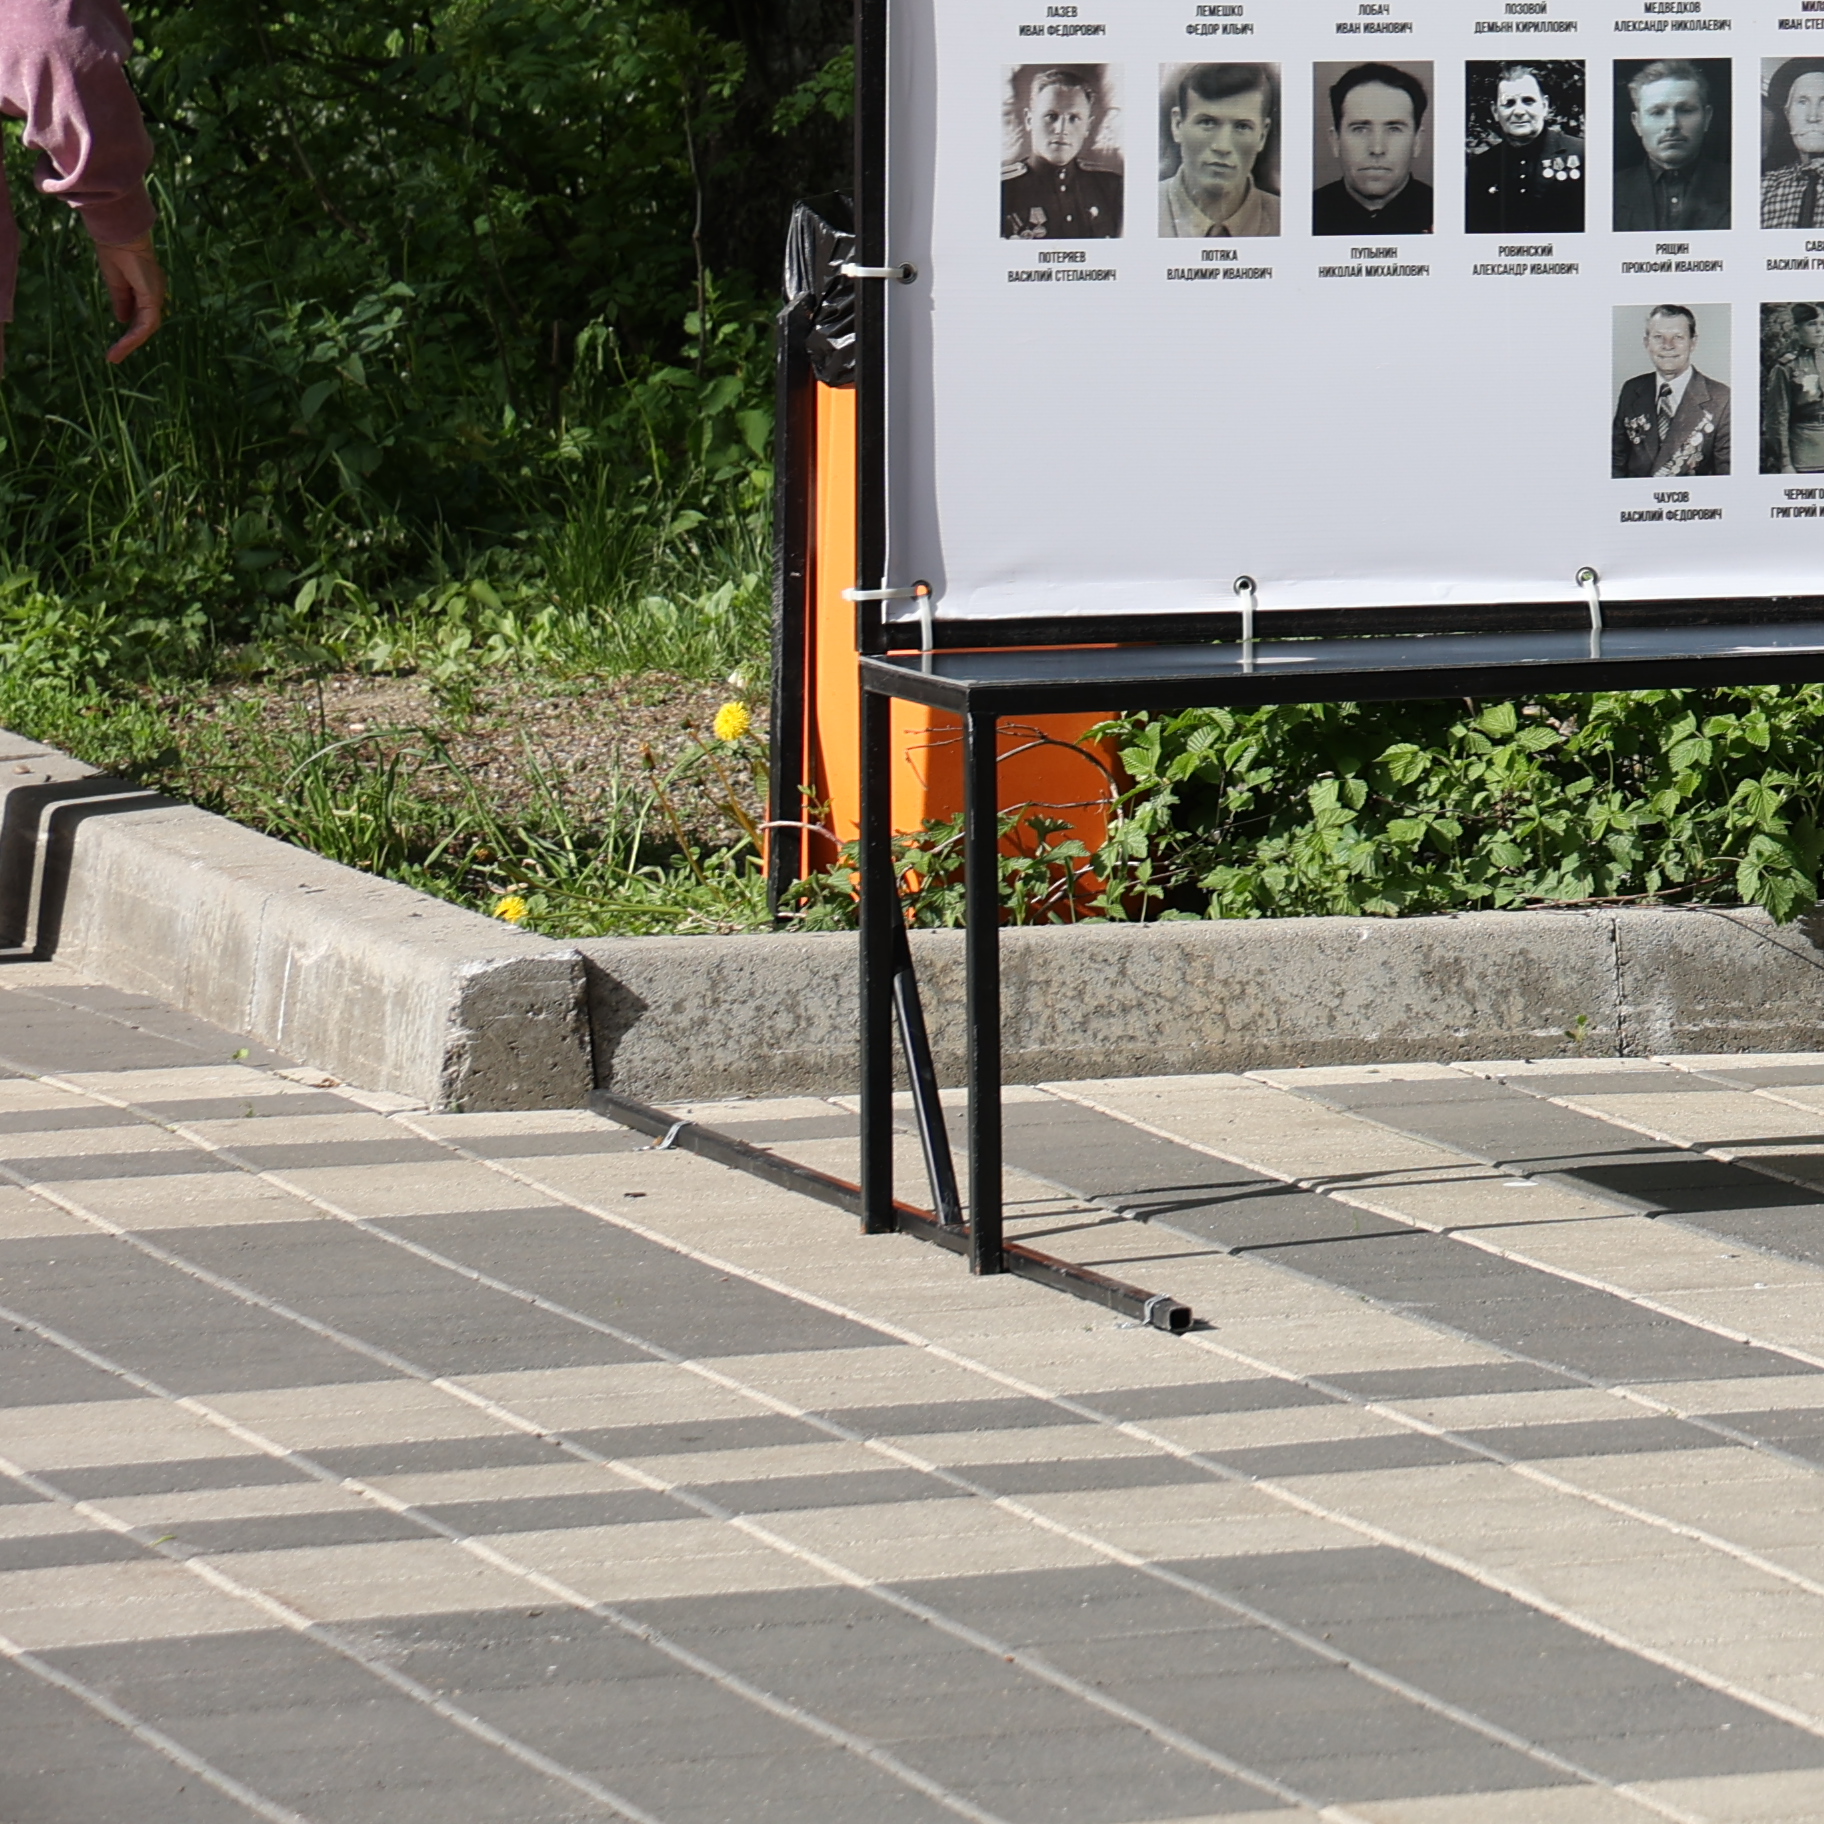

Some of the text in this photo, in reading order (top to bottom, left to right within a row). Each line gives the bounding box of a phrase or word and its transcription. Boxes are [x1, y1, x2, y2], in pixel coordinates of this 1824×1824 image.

[1046, 5, 1078, 18] ЛАЗЕВ
[1195, 4, 1244, 17] ЛЕМЕШКО
[1358, 3, 1390, 16] ЛОБАЧ
[1504, 0, 1547, 15] ЛОЗОВОЙ
[1644, 1, 1702, 15] МЕДВЕДКОВ
[1018, 24, 1106, 38] ИВАН ФЕДОРОВИЧ
[1186, 23, 1254, 36] ФЕДОР ИЛЬИЧ
[1335, 21, 1413, 34] ИВАН ИВАНОВИЧ
[1474, 20, 1578, 34] ДЕМЬЯН КИРИЛЛОВИЧ
[1614, 19, 1732, 33] АЛЕКСАНДР НИКОЛАЕВИЧ
[1778, 18, 1803, 30] ИВАН
[1038, 251, 1086, 264] ПОТЕРЯЕВ
[1201, 249, 1238, 262] ПОТЯКА
[1498, 243, 1554, 258] РОВИНСКИЙ
[1008, 267, 1116, 283] ВАСИЛИЙ СТЕПАНОВИЧ
[1166, 267, 1273, 282] ВЛАДИМИР ИВАНОВИЧ
[1472, 262, 1579, 277] АЛЕКСАНДР ИВАНОВИЧ
[1653, 491, 1690, 504] ЧАУСОВ
[1620, 507, 1722, 523] ВАСИЛИЙ ФЕДОРОВИЧ
[1770, 504, 1818, 518] ГРИГОРИЙ
